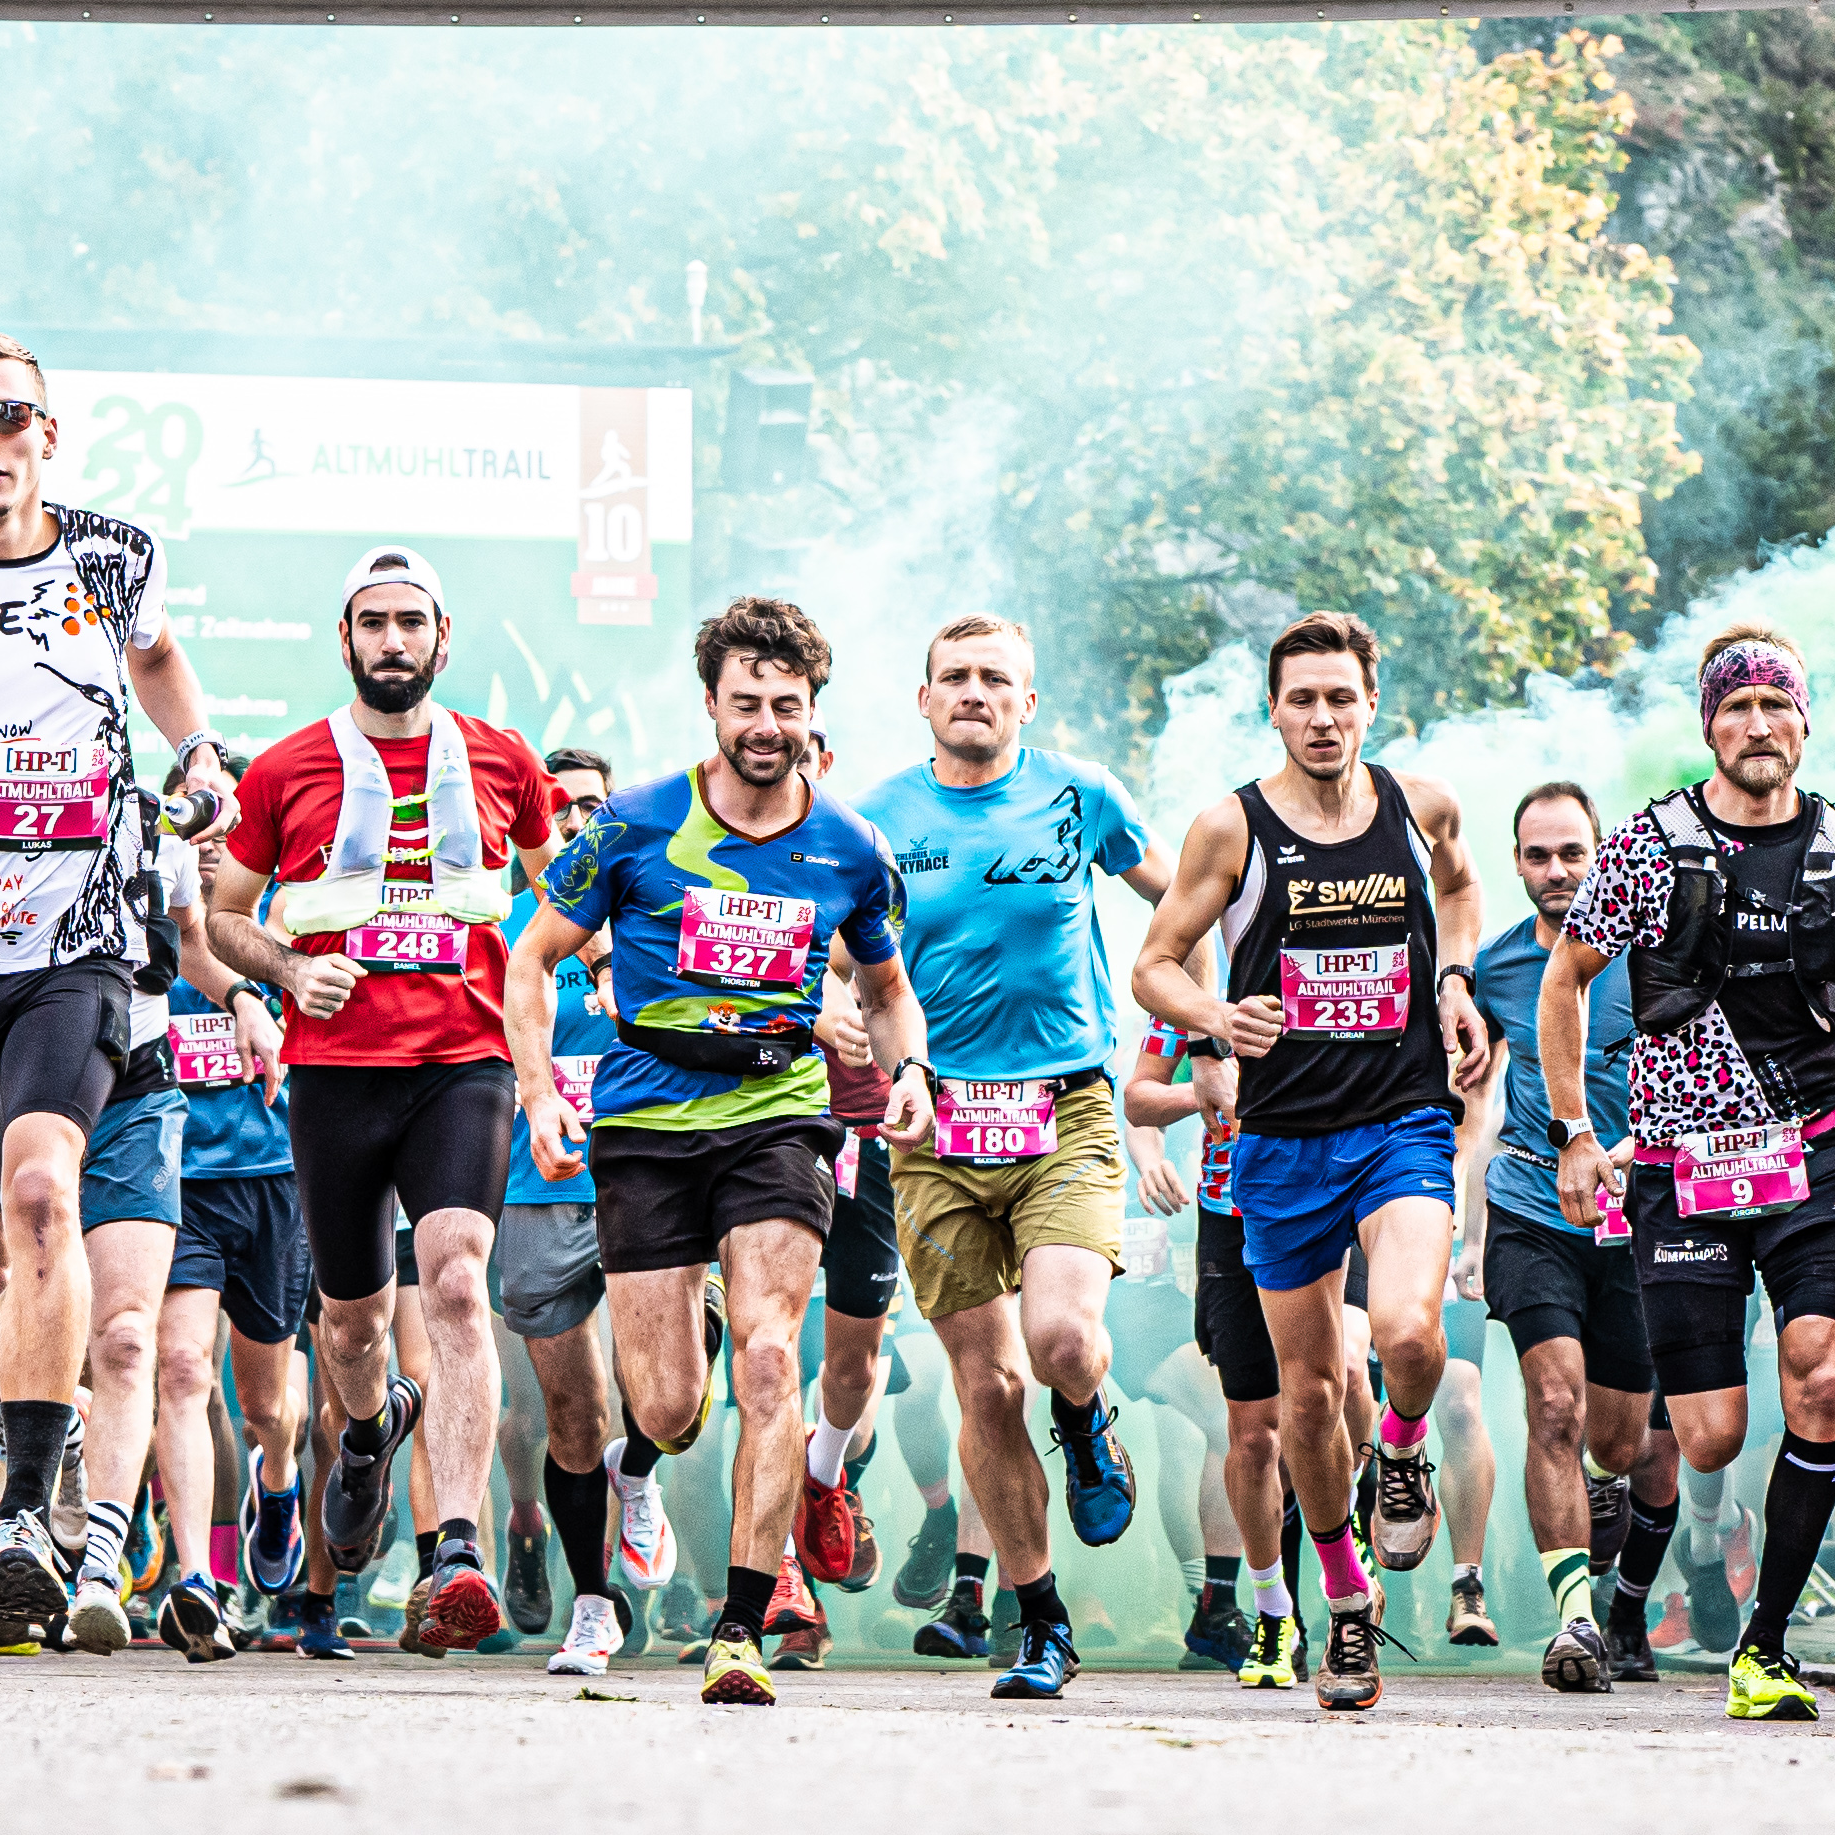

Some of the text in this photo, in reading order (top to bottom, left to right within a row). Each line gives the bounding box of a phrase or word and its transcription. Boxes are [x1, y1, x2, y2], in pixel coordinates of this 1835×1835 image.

[584, 503, 643, 563] 10
[12, 805, 65, 836] 27
[22, 840, 53, 849] LUKAS
[898, 856, 950, 875] KYRACE
[381, 885, 434, 905] [HP-T
[1289, 913, 1405, 932] LG Stadtwerke München
[376, 932, 440, 960] 248
[709, 943, 777, 976] 327
[720, 976, 761, 988] THORSTEN
[190, 1016, 233, 1035] [HP-T
[1314, 1000, 1381, 1028] 235
[1330, 1031, 1365, 1039] FLORIAN
[191, 1054, 243, 1078] 125
[966, 1126, 1026, 1153] 180
[1730, 1178, 1754, 1205] 9
